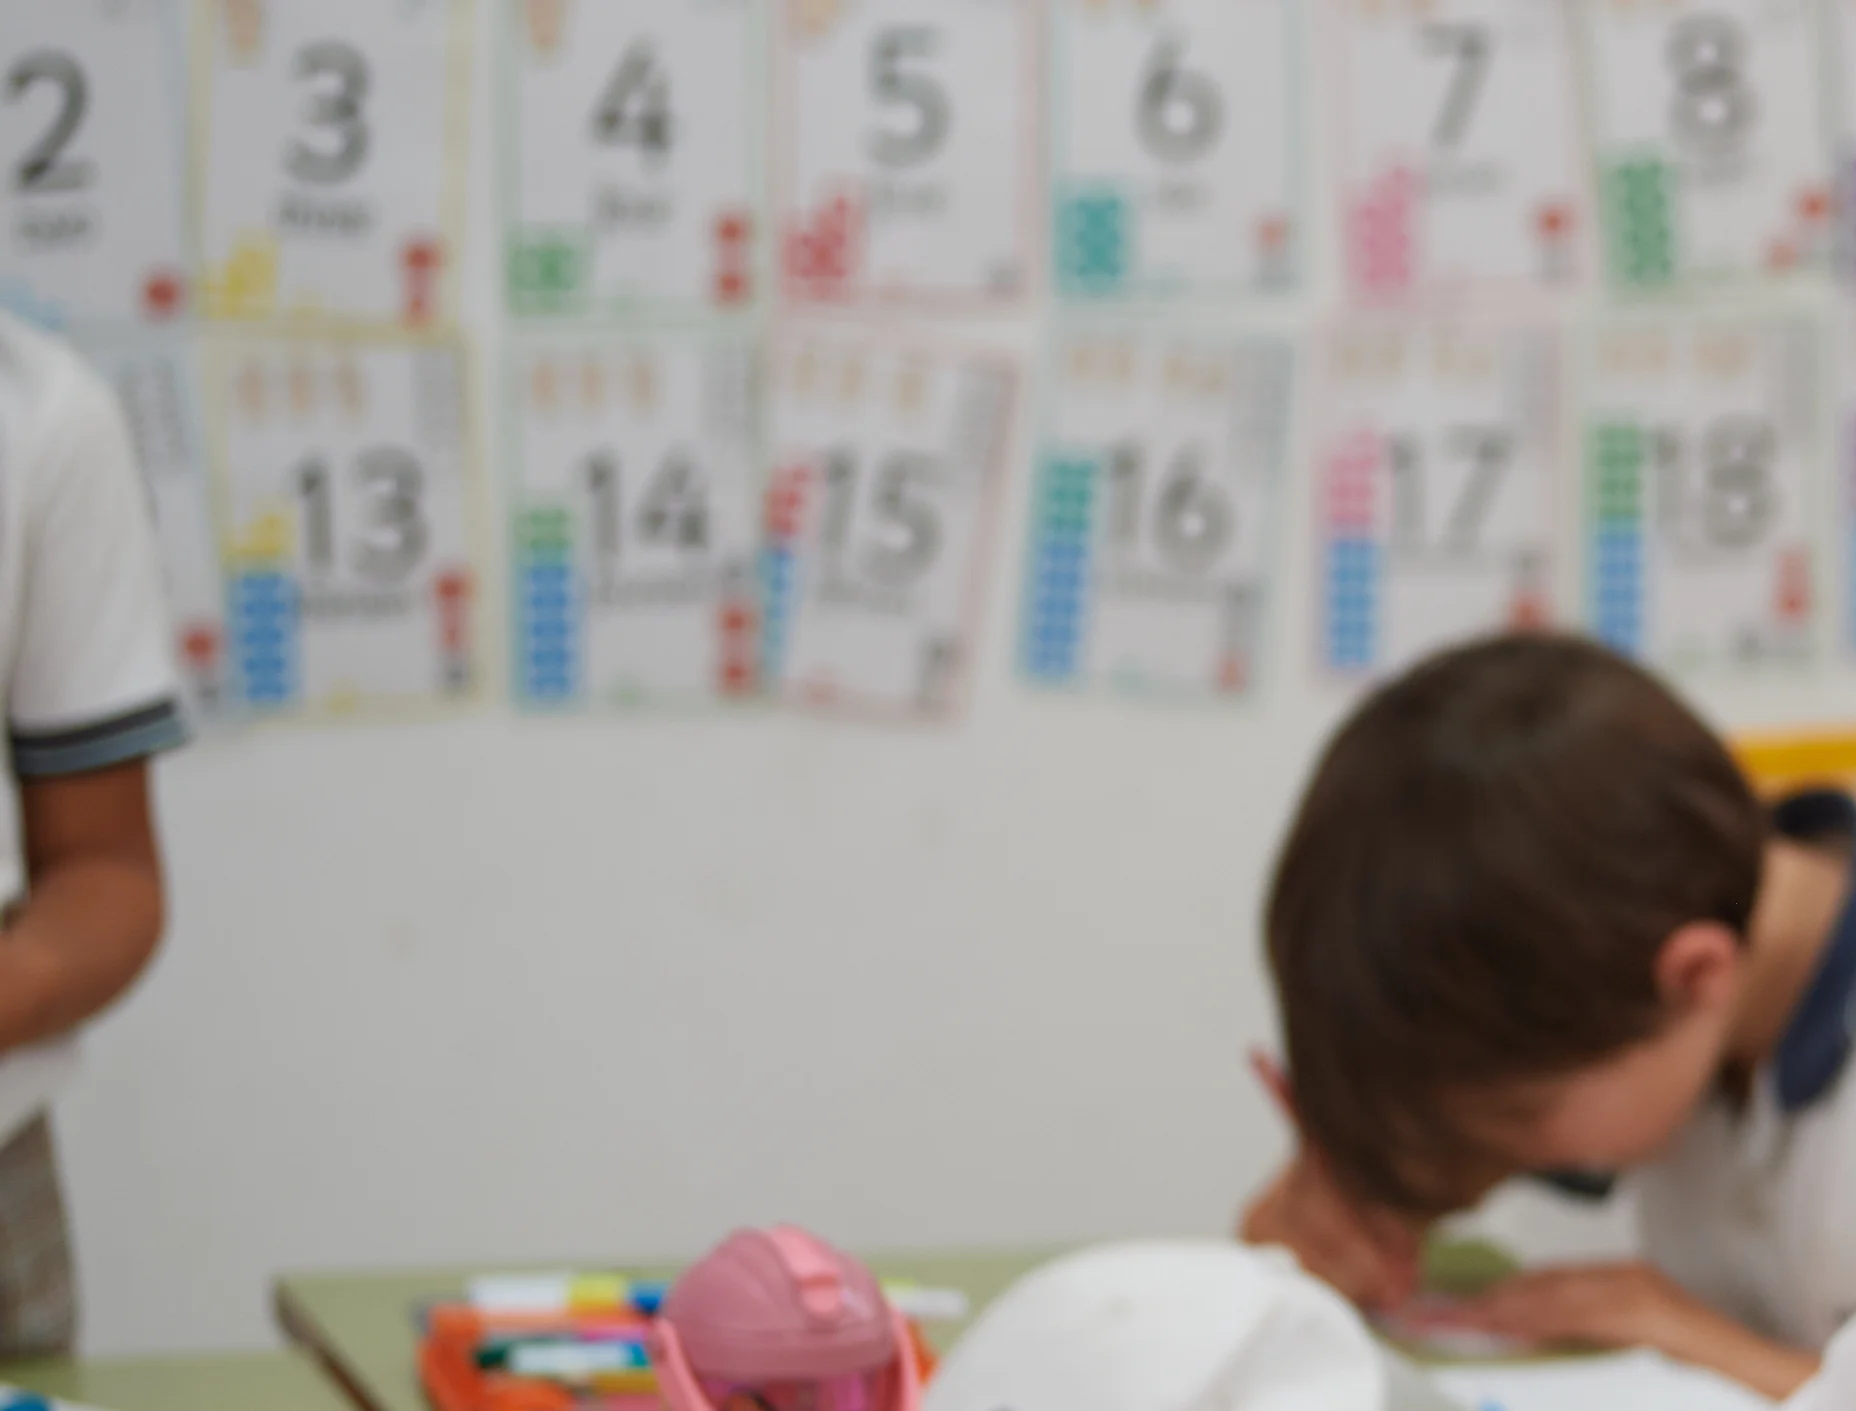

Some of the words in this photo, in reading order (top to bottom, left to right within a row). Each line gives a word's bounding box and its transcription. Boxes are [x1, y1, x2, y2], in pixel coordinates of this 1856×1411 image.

[5, 47, 96, 190] 2
[285, 40, 370, 186] 3
[590, 37, 673, 166] 4
[860, 24, 951, 168] 5
[1134, 28, 1226, 164] 6
[1417, 22, 1494, 150] 7
[1666, 14, 1756, 155] 8
[298, 447, 430, 586] 13
[587, 447, 710, 555] 14
[820, 447, 944, 587] 15
[1110, 438, 1238, 572] 16
[1390, 424, 1515, 556] 17
[1654, 414, 1779, 549] 18
